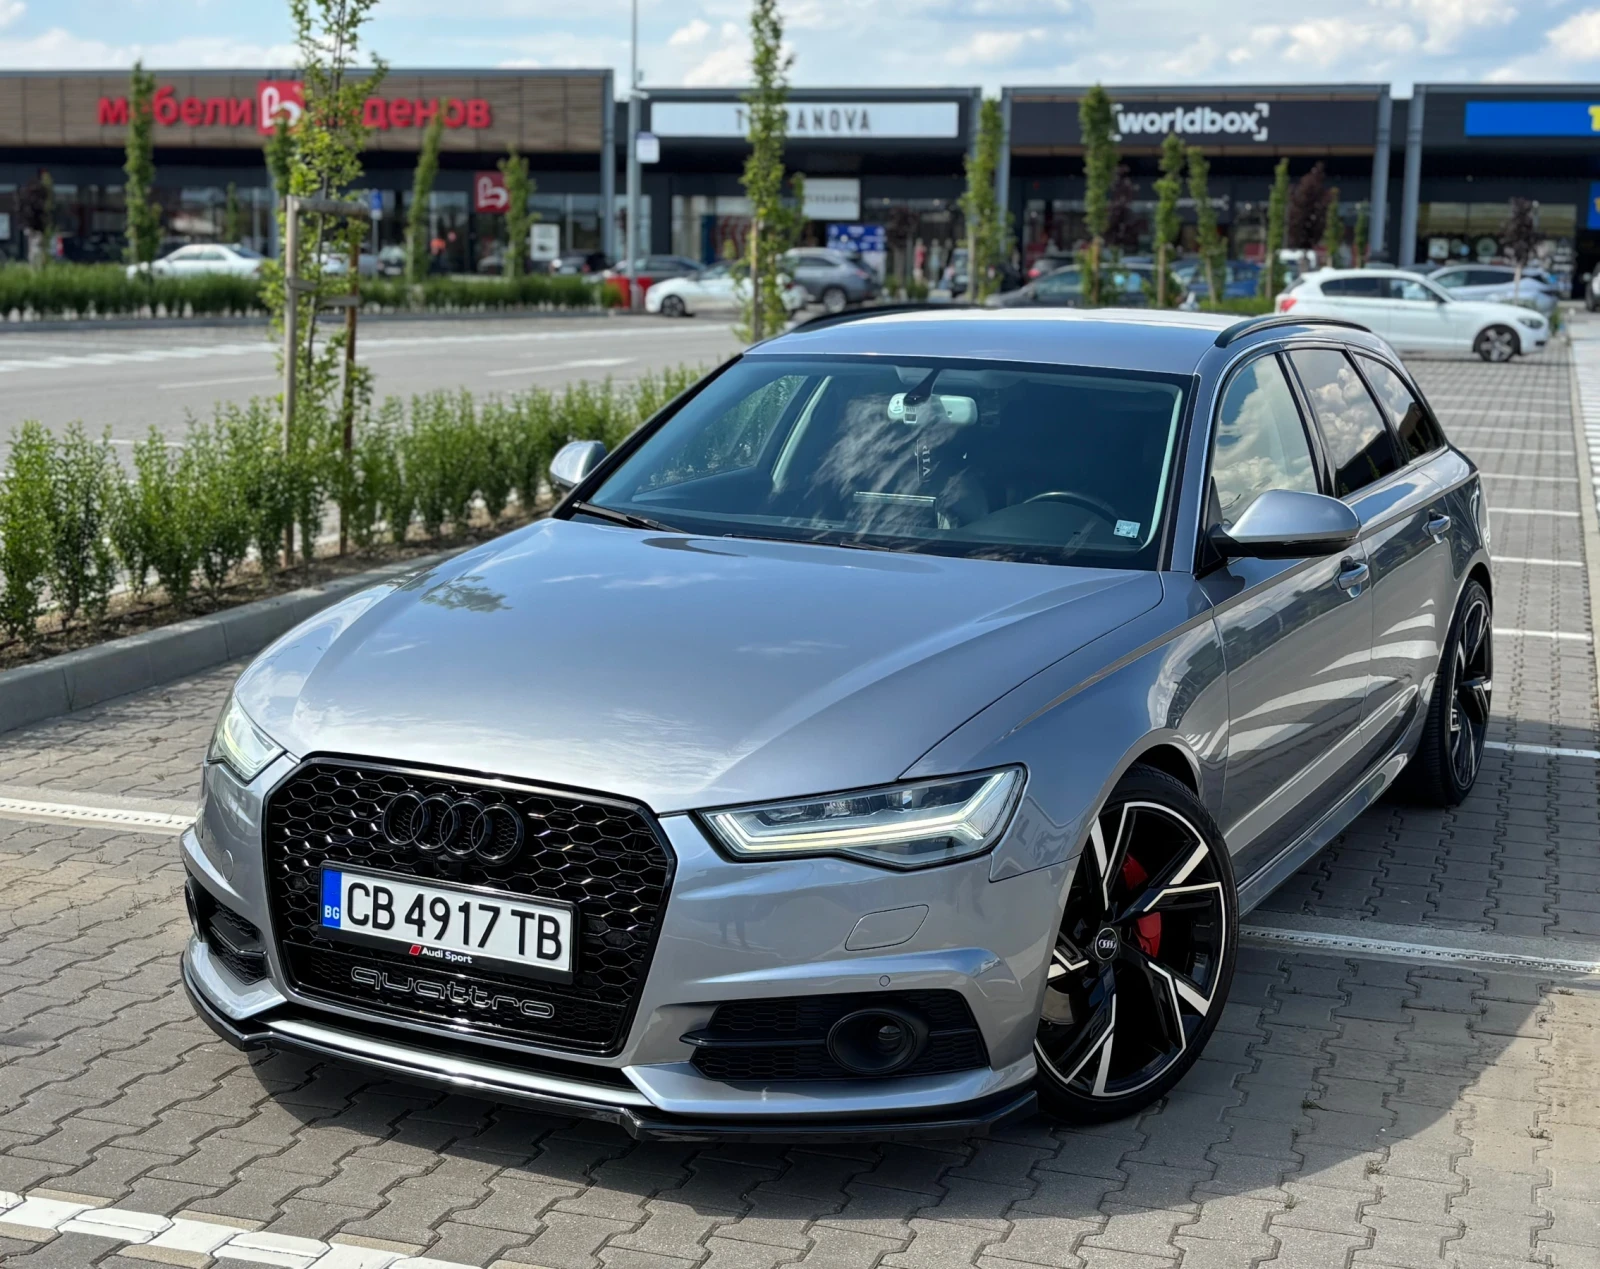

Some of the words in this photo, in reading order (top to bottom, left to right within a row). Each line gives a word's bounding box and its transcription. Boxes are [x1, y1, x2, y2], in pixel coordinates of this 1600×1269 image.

[98, 85, 253, 127] мбели
[312, 96, 490, 131] денов
[734, 107, 870, 131] TANOVA
[1117, 106, 1259, 134] worldbox
[324, 905, 340, 920] BG
[347, 883, 395, 931] CB
[404, 893, 501, 948] 4917
[510, 909, 562, 961] TB
[421, 947, 444, 959] Audi
[445, 951, 473, 964] Sport
[350, 966, 555, 1019] quattro
